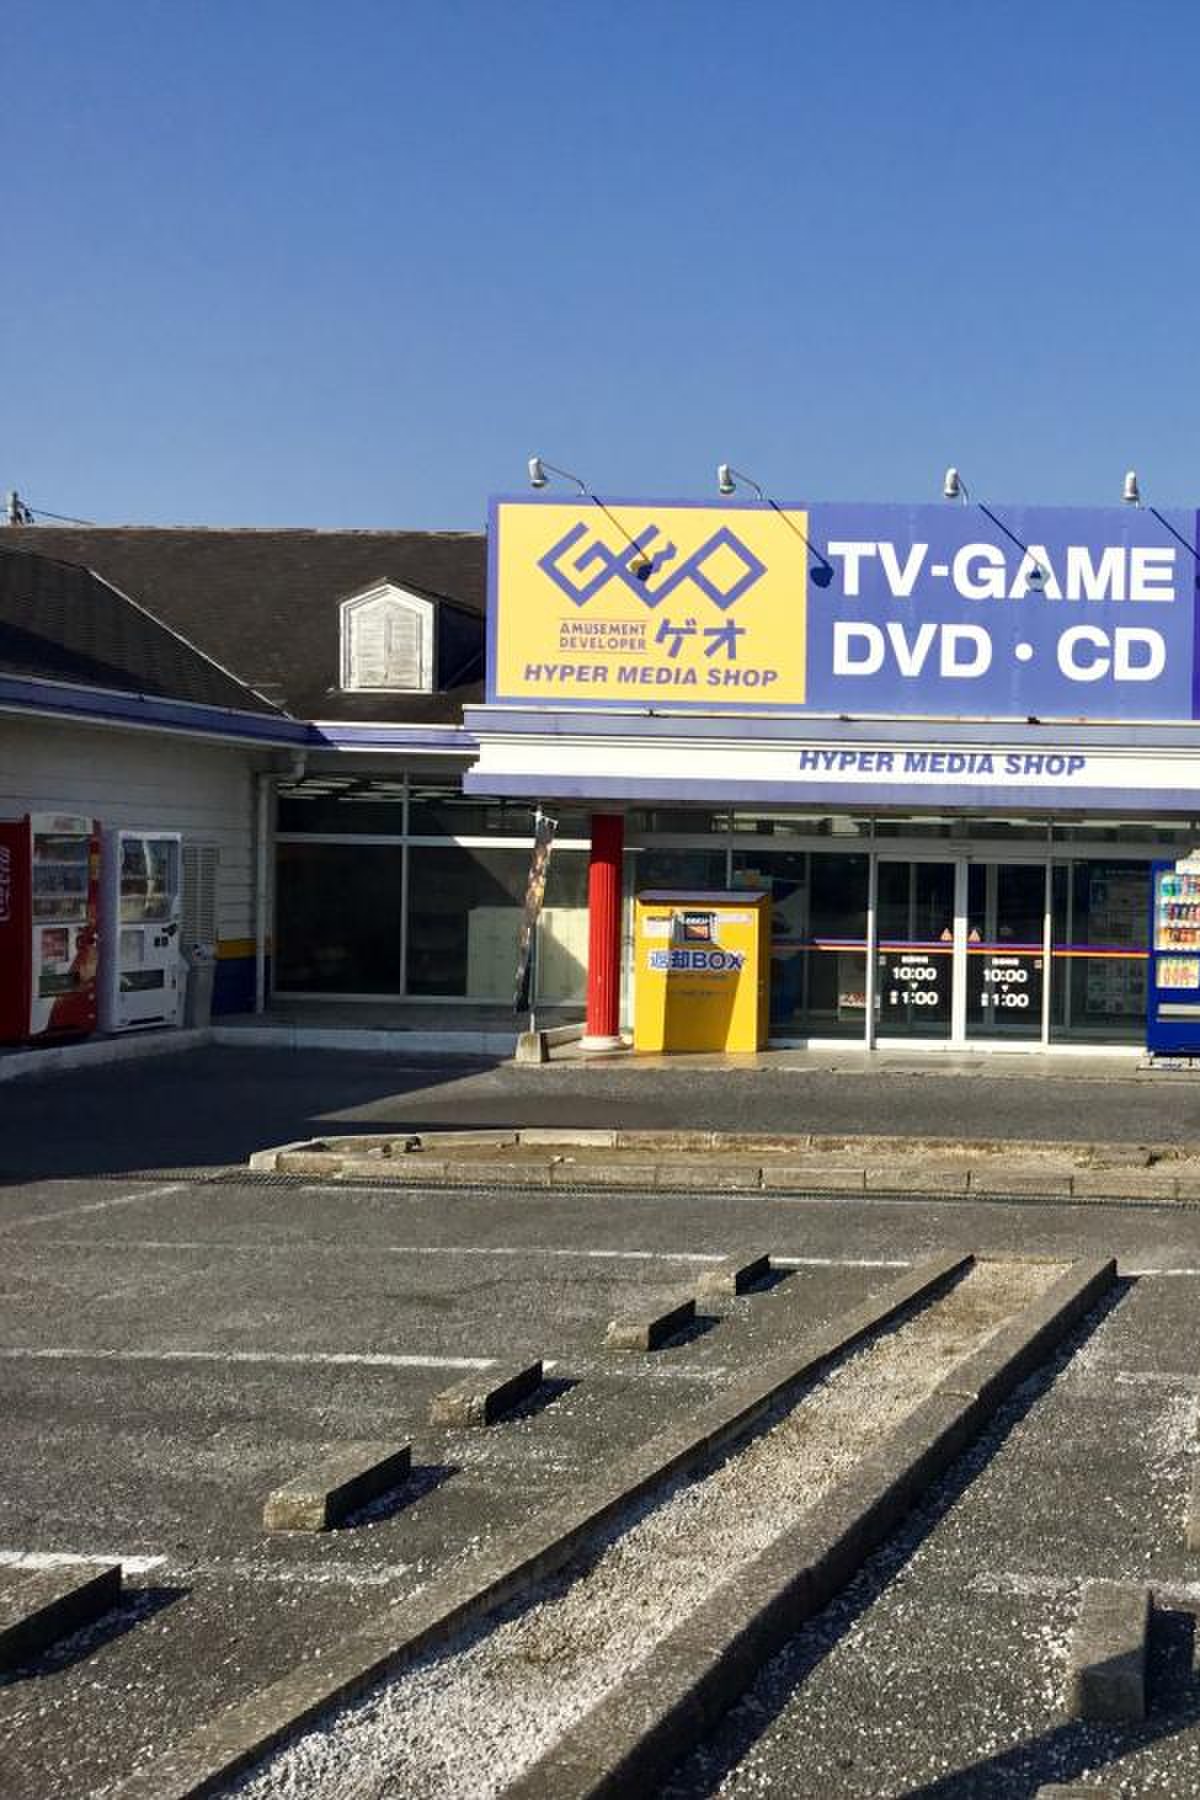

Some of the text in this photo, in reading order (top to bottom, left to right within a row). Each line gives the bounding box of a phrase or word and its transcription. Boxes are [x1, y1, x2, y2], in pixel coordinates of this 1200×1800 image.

[828, 542, 1176, 602] TV-GAME
[559, 622, 648, 636] AMUSEMENT
[654, 617, 746, 661] ゲオ
[559, 636, 647, 650] DEVELOPER
[833, 622, 993, 679] DVD
[1057, 625, 1167, 681] CD
[524, 663, 778, 687] HYPER MEDIA SHOP
[799, 750, 1086, 776] HYPER MEDIA SHOP
[893, 967, 937, 981] 10:00
[983, 968, 1028, 983] 10:00
